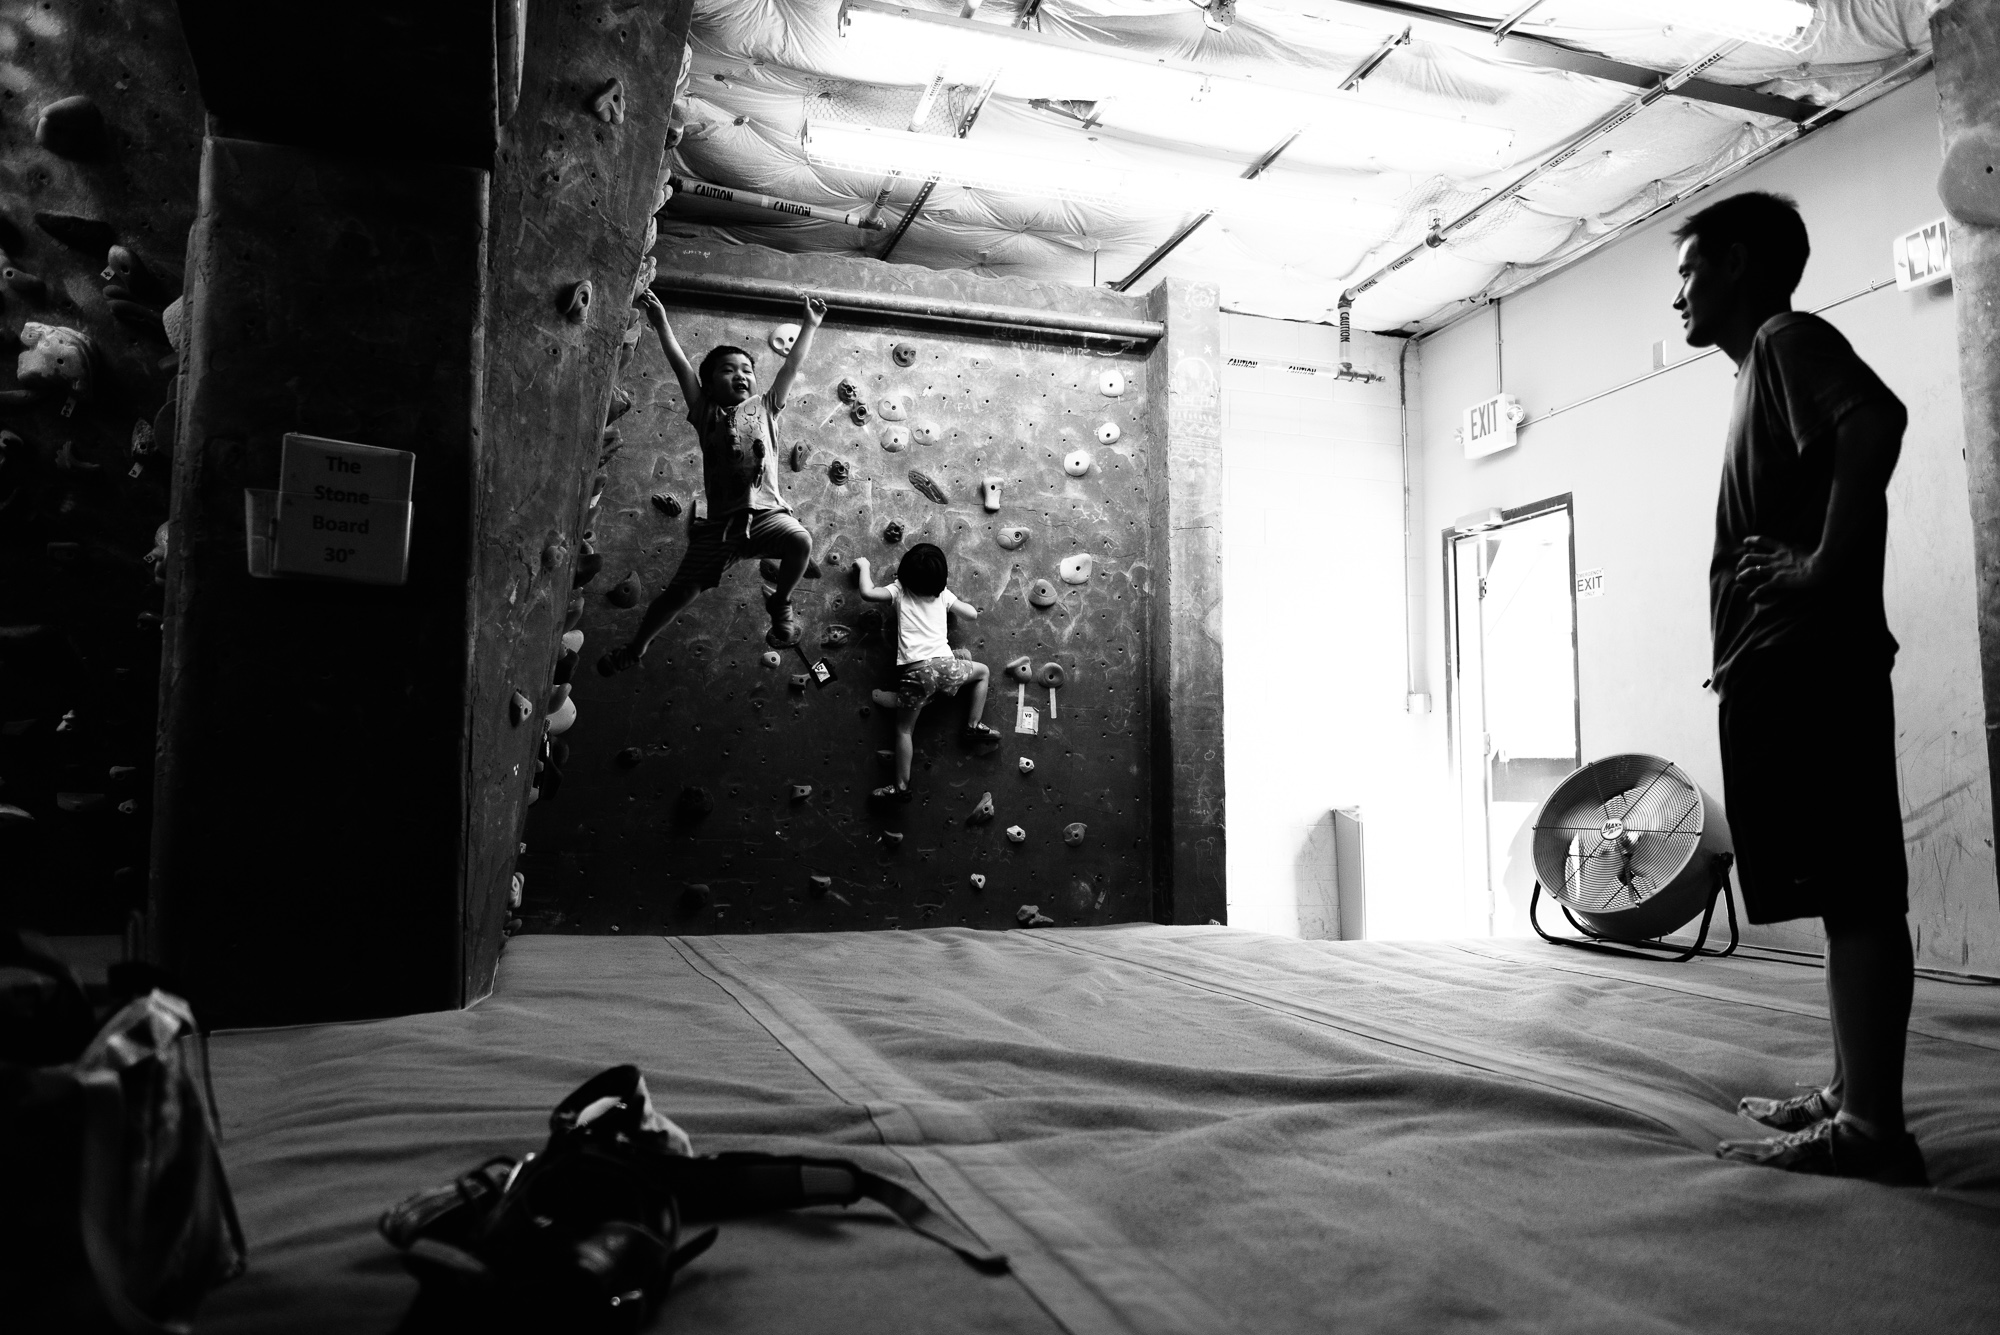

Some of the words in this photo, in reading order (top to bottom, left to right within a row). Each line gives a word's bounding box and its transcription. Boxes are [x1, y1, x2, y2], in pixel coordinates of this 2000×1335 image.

[694, 184, 734, 202] CAUTION
[773, 201, 812, 218] CAUTION
[1905, 221, 1948, 282] EXI
[1339, 311, 1351, 343] CAUTION
[1470, 399, 1498, 441] EXIT
[325, 456, 362, 474] The
[314, 485, 370, 505] Stone
[312, 515, 370, 534] Board
[324, 547, 356, 563] 30°
[1577, 575, 1603, 592] EXIT
